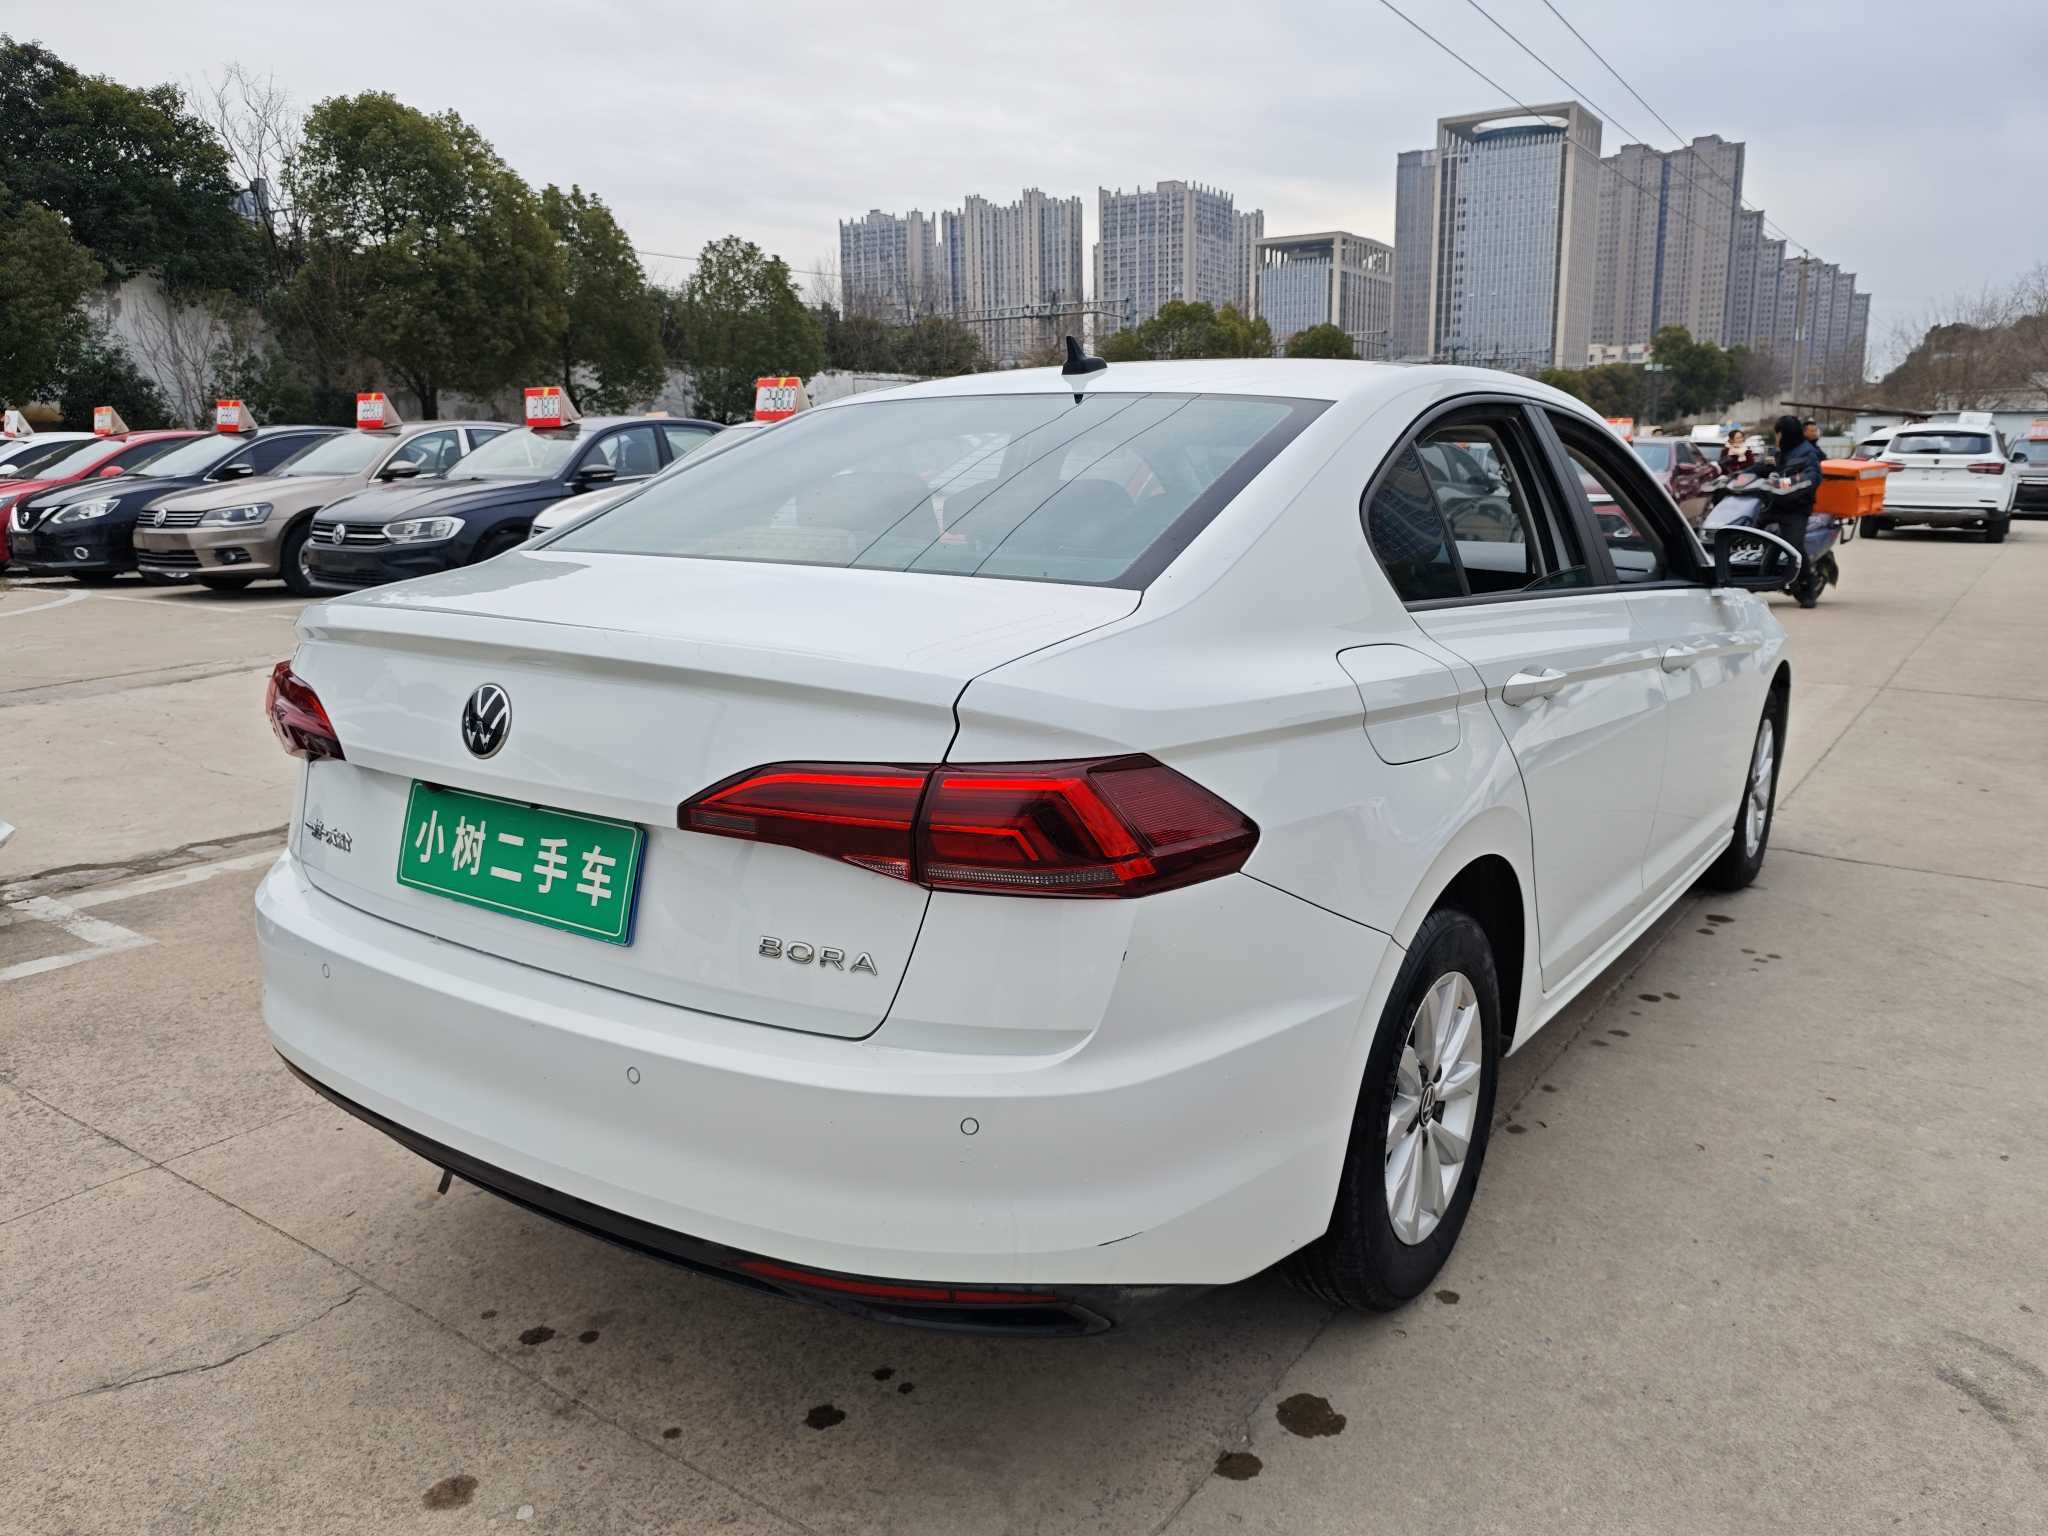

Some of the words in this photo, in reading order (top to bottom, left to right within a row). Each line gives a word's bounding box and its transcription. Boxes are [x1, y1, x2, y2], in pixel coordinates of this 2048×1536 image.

[415, 810, 617, 907] 小树二手车
[758, 935, 878, 977] BORA
